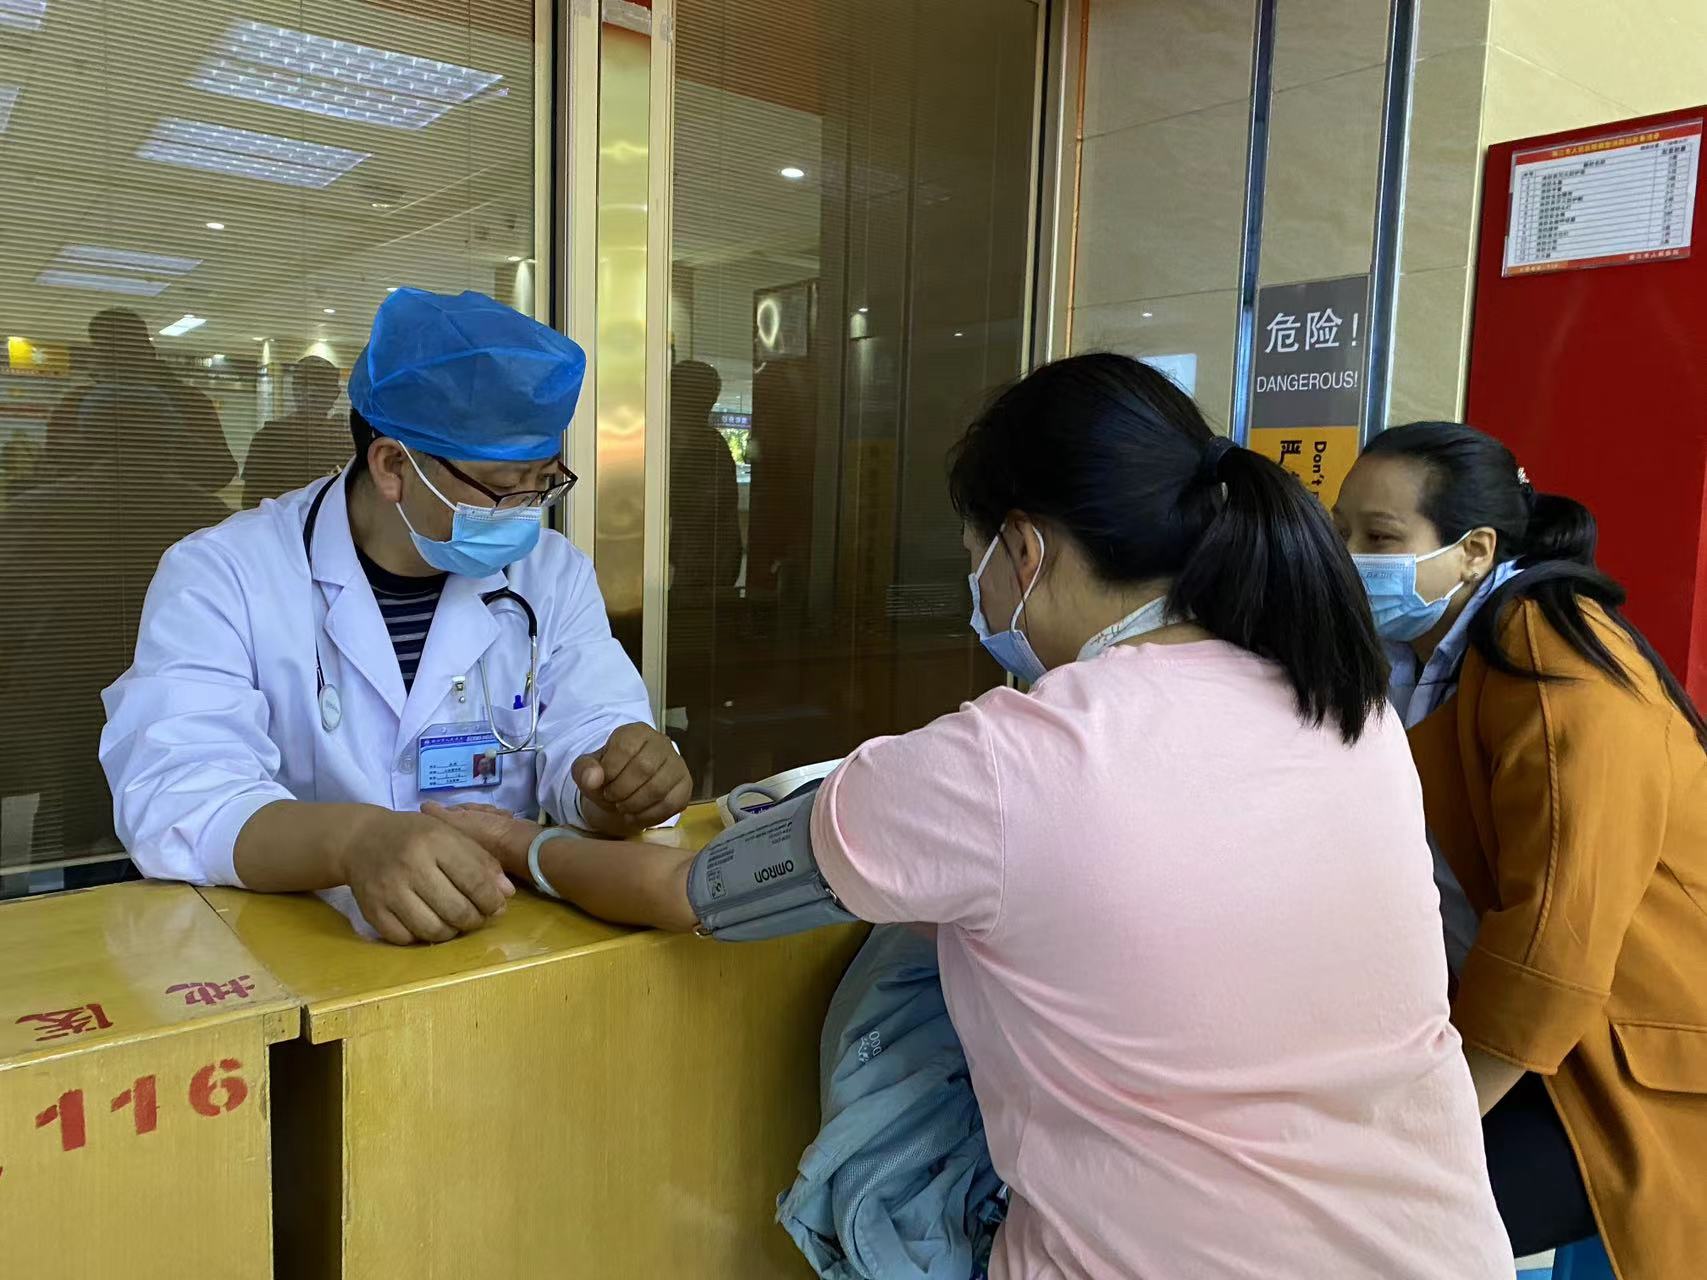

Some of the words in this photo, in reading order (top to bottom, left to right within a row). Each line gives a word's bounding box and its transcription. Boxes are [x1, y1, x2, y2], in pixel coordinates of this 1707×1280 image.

[1264, 308, 1359, 353] 危险！
[1256, 371, 1359, 393] DANGEROUS!
[1312, 441, 1327, 486] Don't
[36, 1060, 248, 1150] 116
